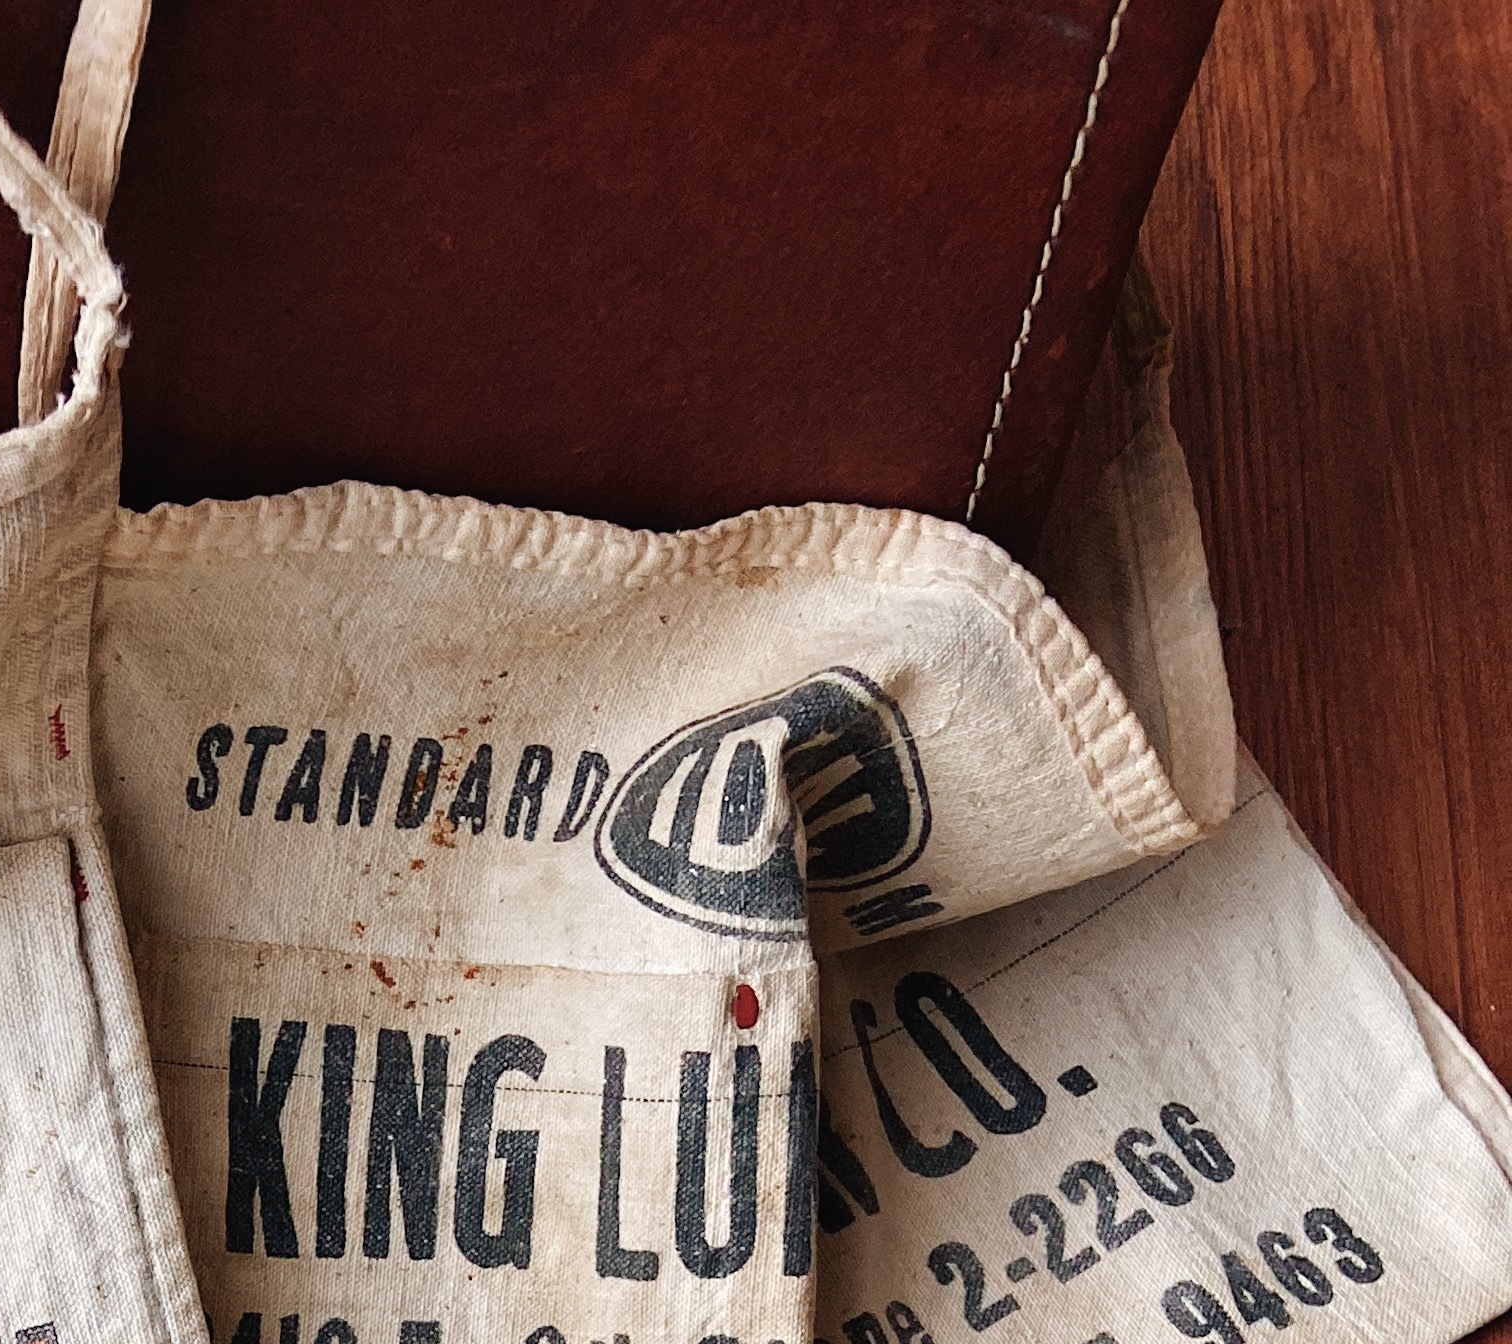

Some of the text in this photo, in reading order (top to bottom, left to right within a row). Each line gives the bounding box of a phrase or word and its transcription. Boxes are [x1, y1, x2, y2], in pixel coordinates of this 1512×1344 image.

[185, 722, 609, 843] STANDARD
[225, 1016, 547, 1270] KING
[850, 970, 1098, 1178] CO.
[928, 1101, 1236, 1333] 2-2266
